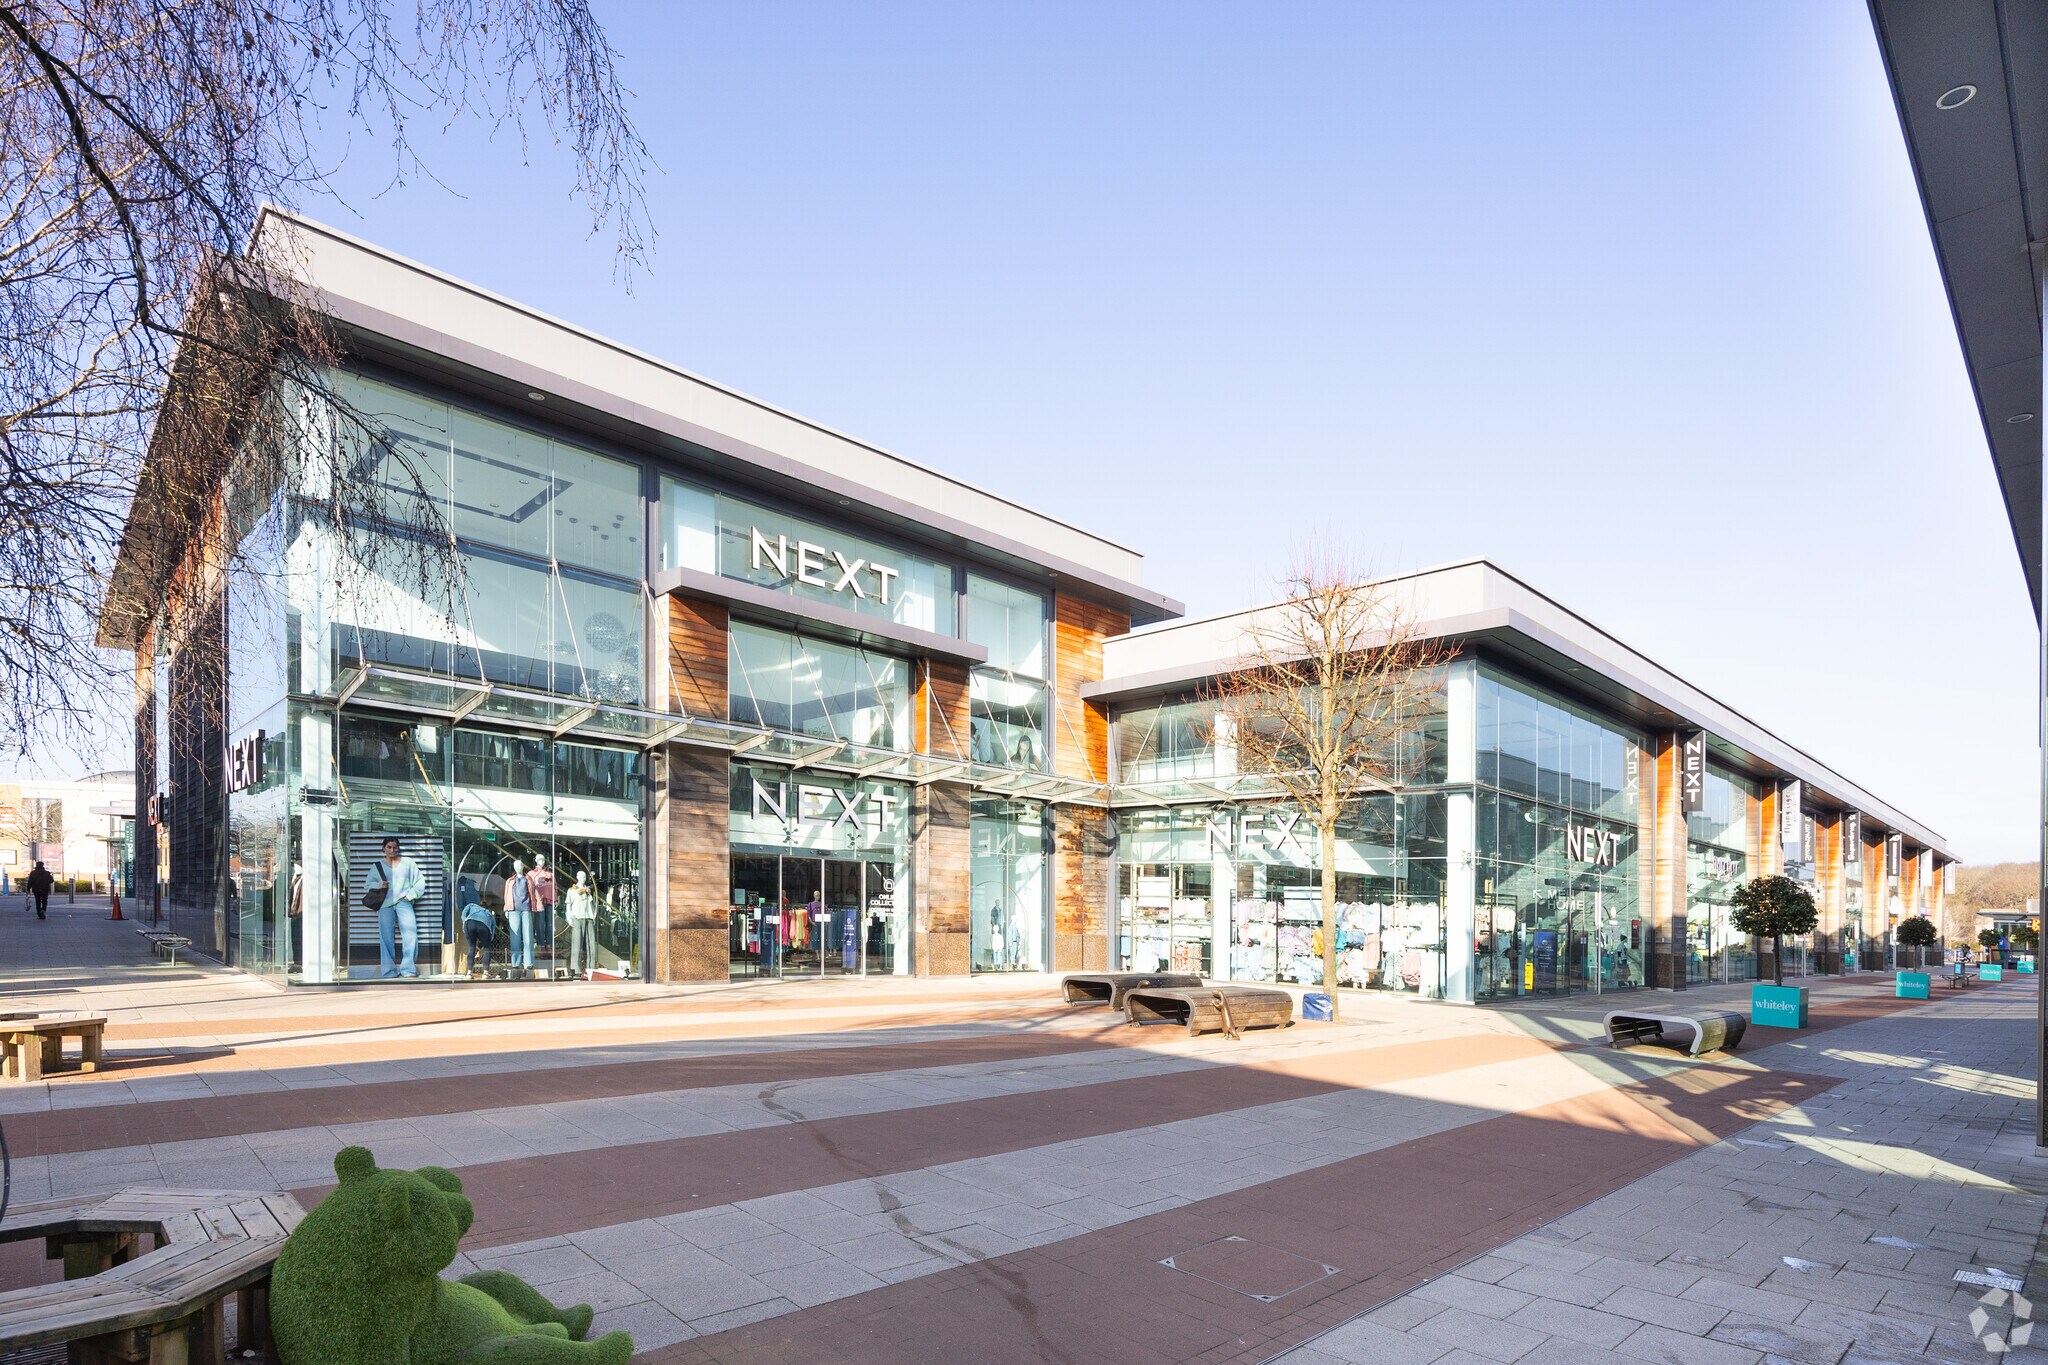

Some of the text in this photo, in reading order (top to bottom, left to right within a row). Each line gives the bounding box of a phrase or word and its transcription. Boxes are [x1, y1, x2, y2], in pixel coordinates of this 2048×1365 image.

[751, 525, 899, 605] NEXT
[224, 729, 266, 794] NEXT
[1686, 740, 1701, 803] NEXT
[751, 777, 899, 833] NEXT
[126, 842, 136, 874] squared
[1564, 822, 1621, 868] NEXT
[127, 874, 135, 889] skin
[1548, 899, 1584, 910] HOME
[1898, 980, 1926, 990] whiteley
[1755, 999, 1797, 1014] whiteley
